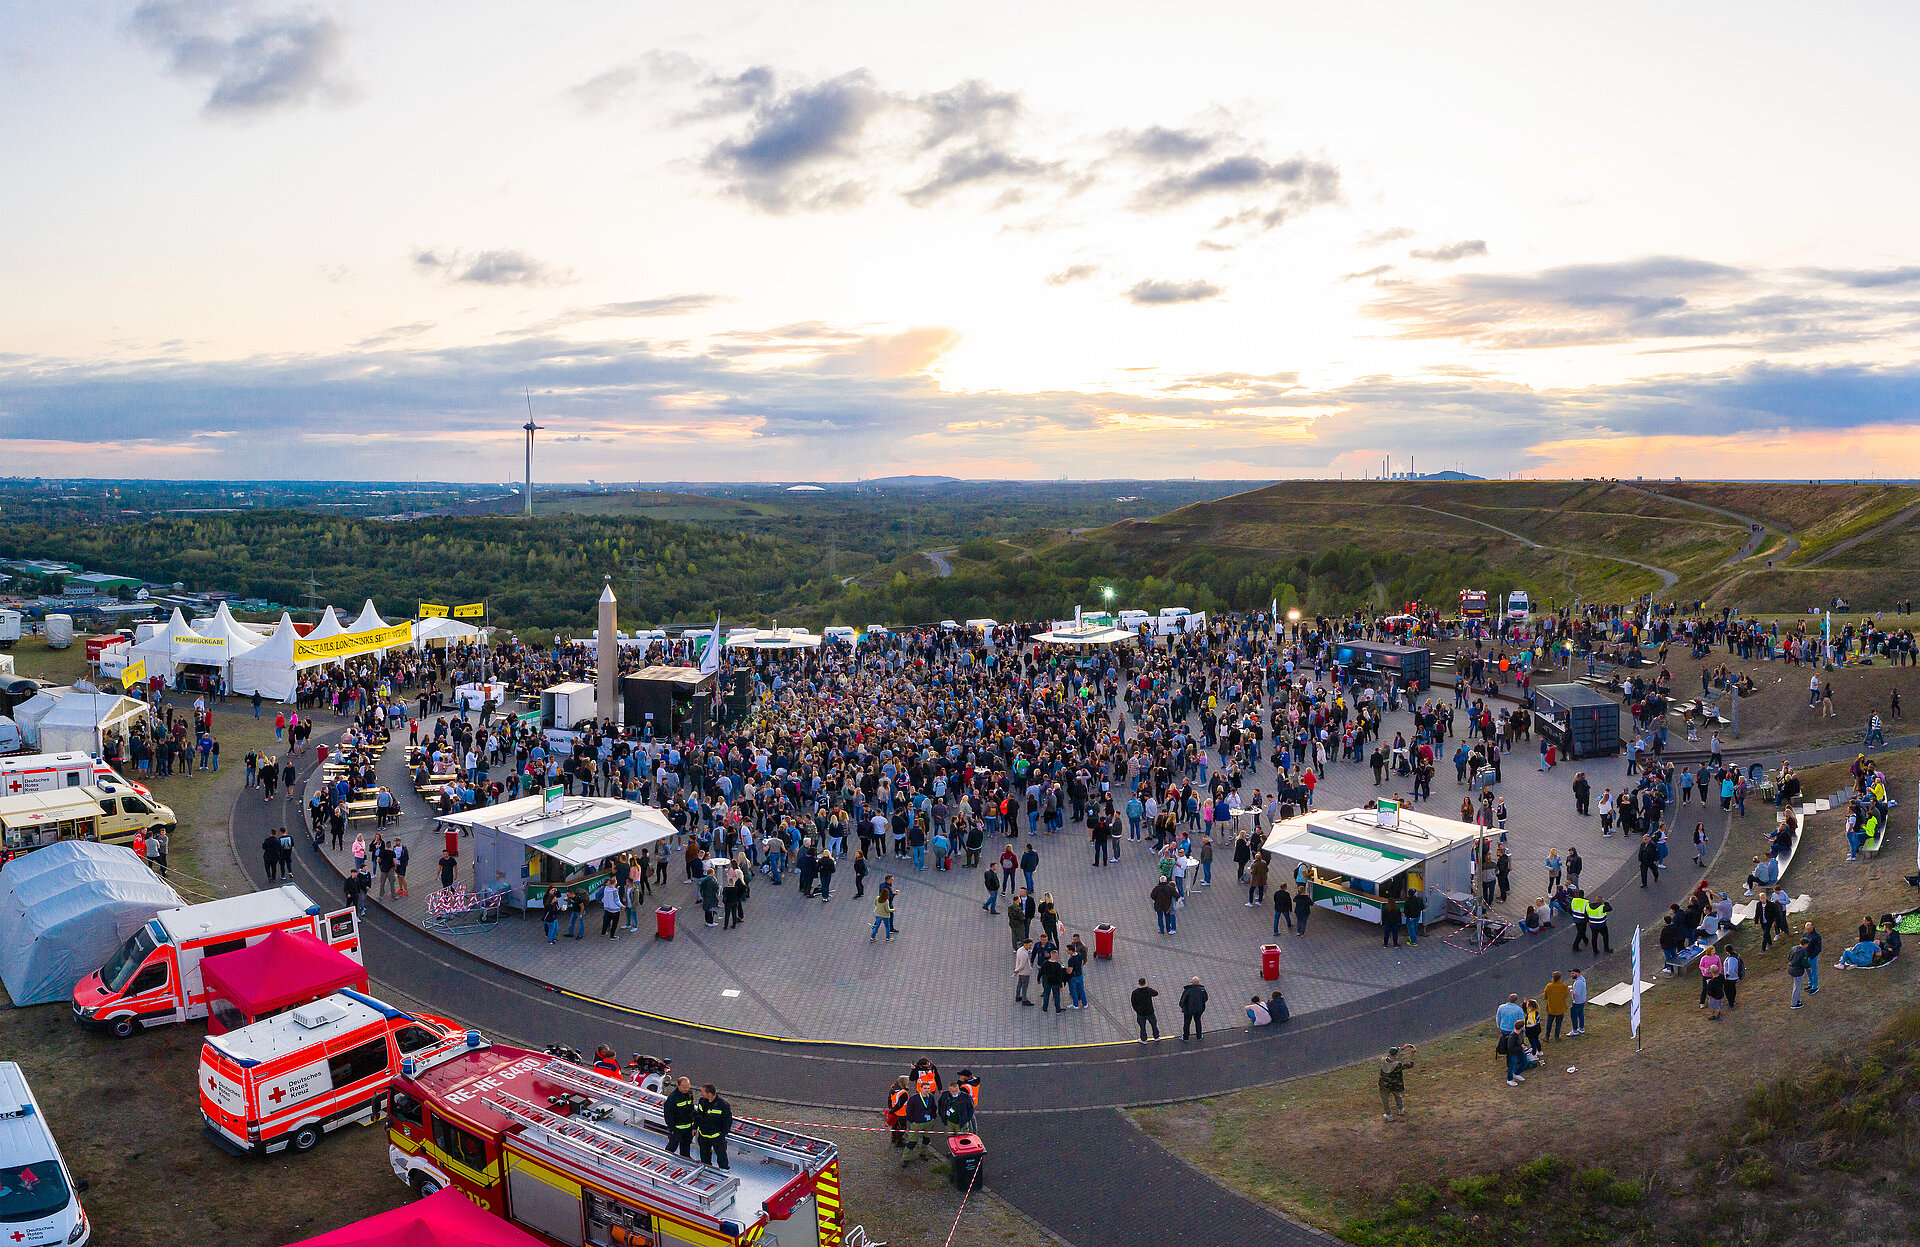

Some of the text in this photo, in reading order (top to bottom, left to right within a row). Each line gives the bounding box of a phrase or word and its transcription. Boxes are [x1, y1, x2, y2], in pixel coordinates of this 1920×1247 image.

[330, 1027, 384, 1052] DRK Einsatzleitung
[288, 1071, 322, 1087] Deutsches
[444, 1058, 541, 1105] RE-HE 6430
[218, 1080, 241, 1098] Deutsches
[218, 1086, 231, 1098] Rotes
[289, 1082, 308, 1093] Rotes
[290, 1088, 309, 1099] Kreuz
[218, 1091, 231, 1103] Kreuz
[0, 1110, 14, 1118] RK
[467, 1190, 491, 1211] 112
[26, 1225, 54, 1233] Deutsches
